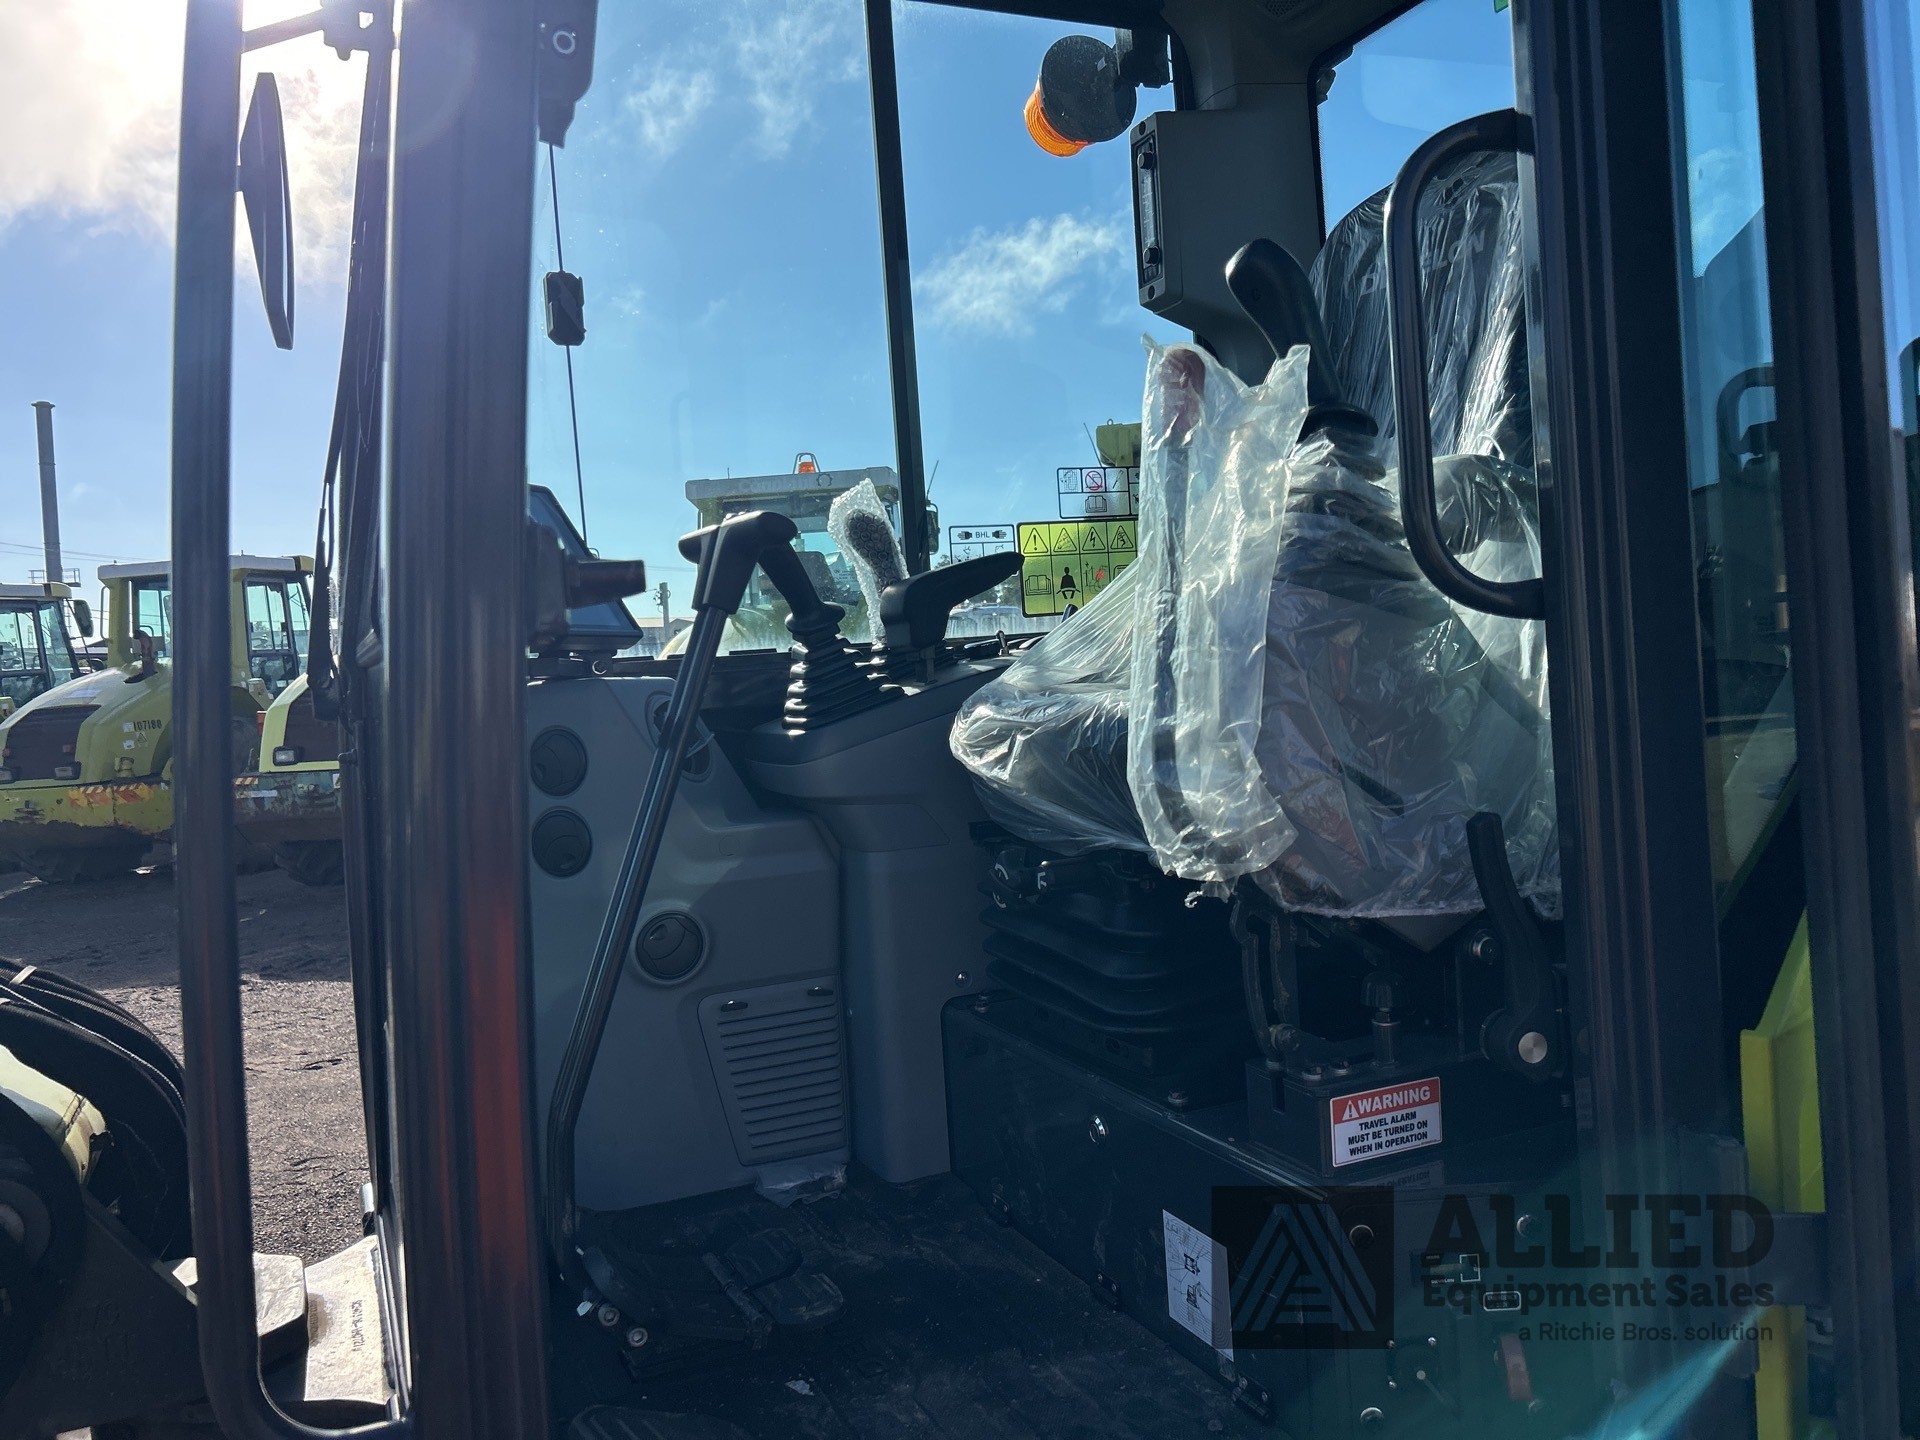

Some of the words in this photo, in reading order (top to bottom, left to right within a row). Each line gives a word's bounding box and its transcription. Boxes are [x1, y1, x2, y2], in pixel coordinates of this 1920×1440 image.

[975, 531, 990, 539] BHL
[1358, 1086, 1431, 1114] WARNING
[1348, 1133, 1370, 1145] MUST
[1373, 1130, 1382, 1140] BE
[1384, 1123, 1415, 1137] TURNED
[1417, 1120, 1428, 1129] ON
[1359, 1118, 1389, 1131] TRAVEL
[1391, 1111, 1417, 1124] ALARM
[1349, 1144, 1372, 1156] WHEN
[1375, 1142, 1382, 1150] IN
[1385, 1131, 1428, 1148] OPERATION
